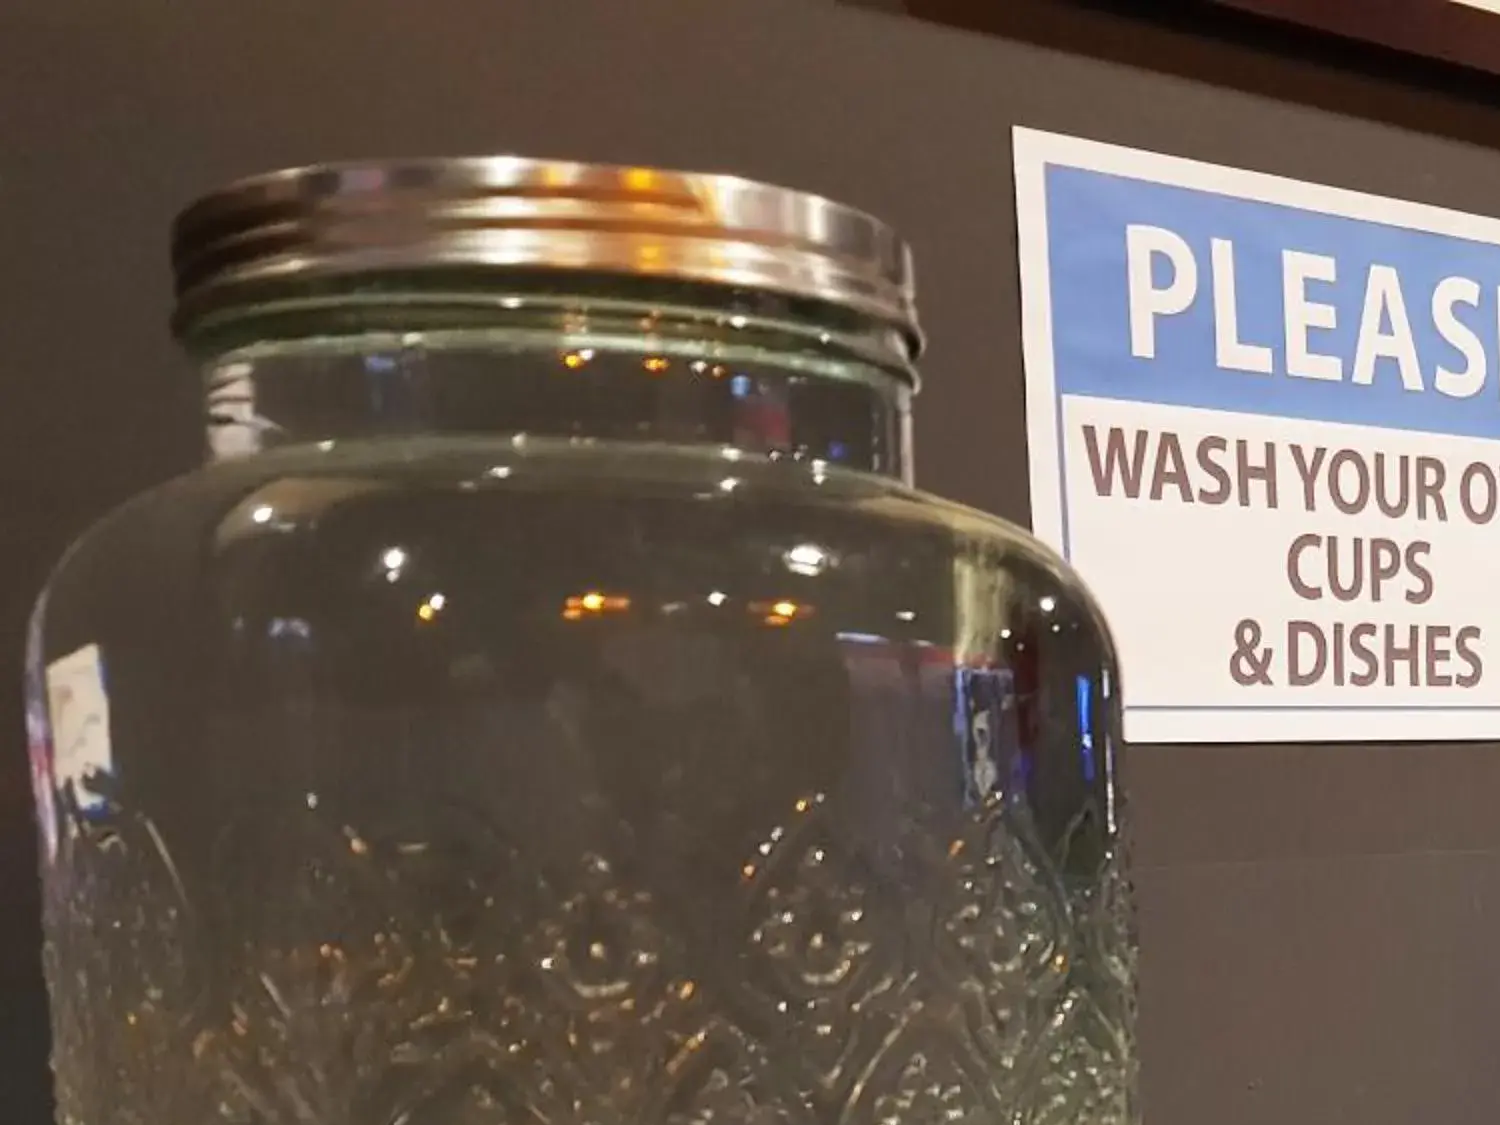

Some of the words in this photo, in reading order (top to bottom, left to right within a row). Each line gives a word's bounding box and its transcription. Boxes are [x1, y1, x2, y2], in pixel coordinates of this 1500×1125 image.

[1082, 424, 1278, 509] WASH
[1290, 444, 1447, 521] YOUR
[1286, 534, 1434, 605] CUPS
[1229, 618, 1274, 688] &
[1287, 620, 1483, 689] DISHES
